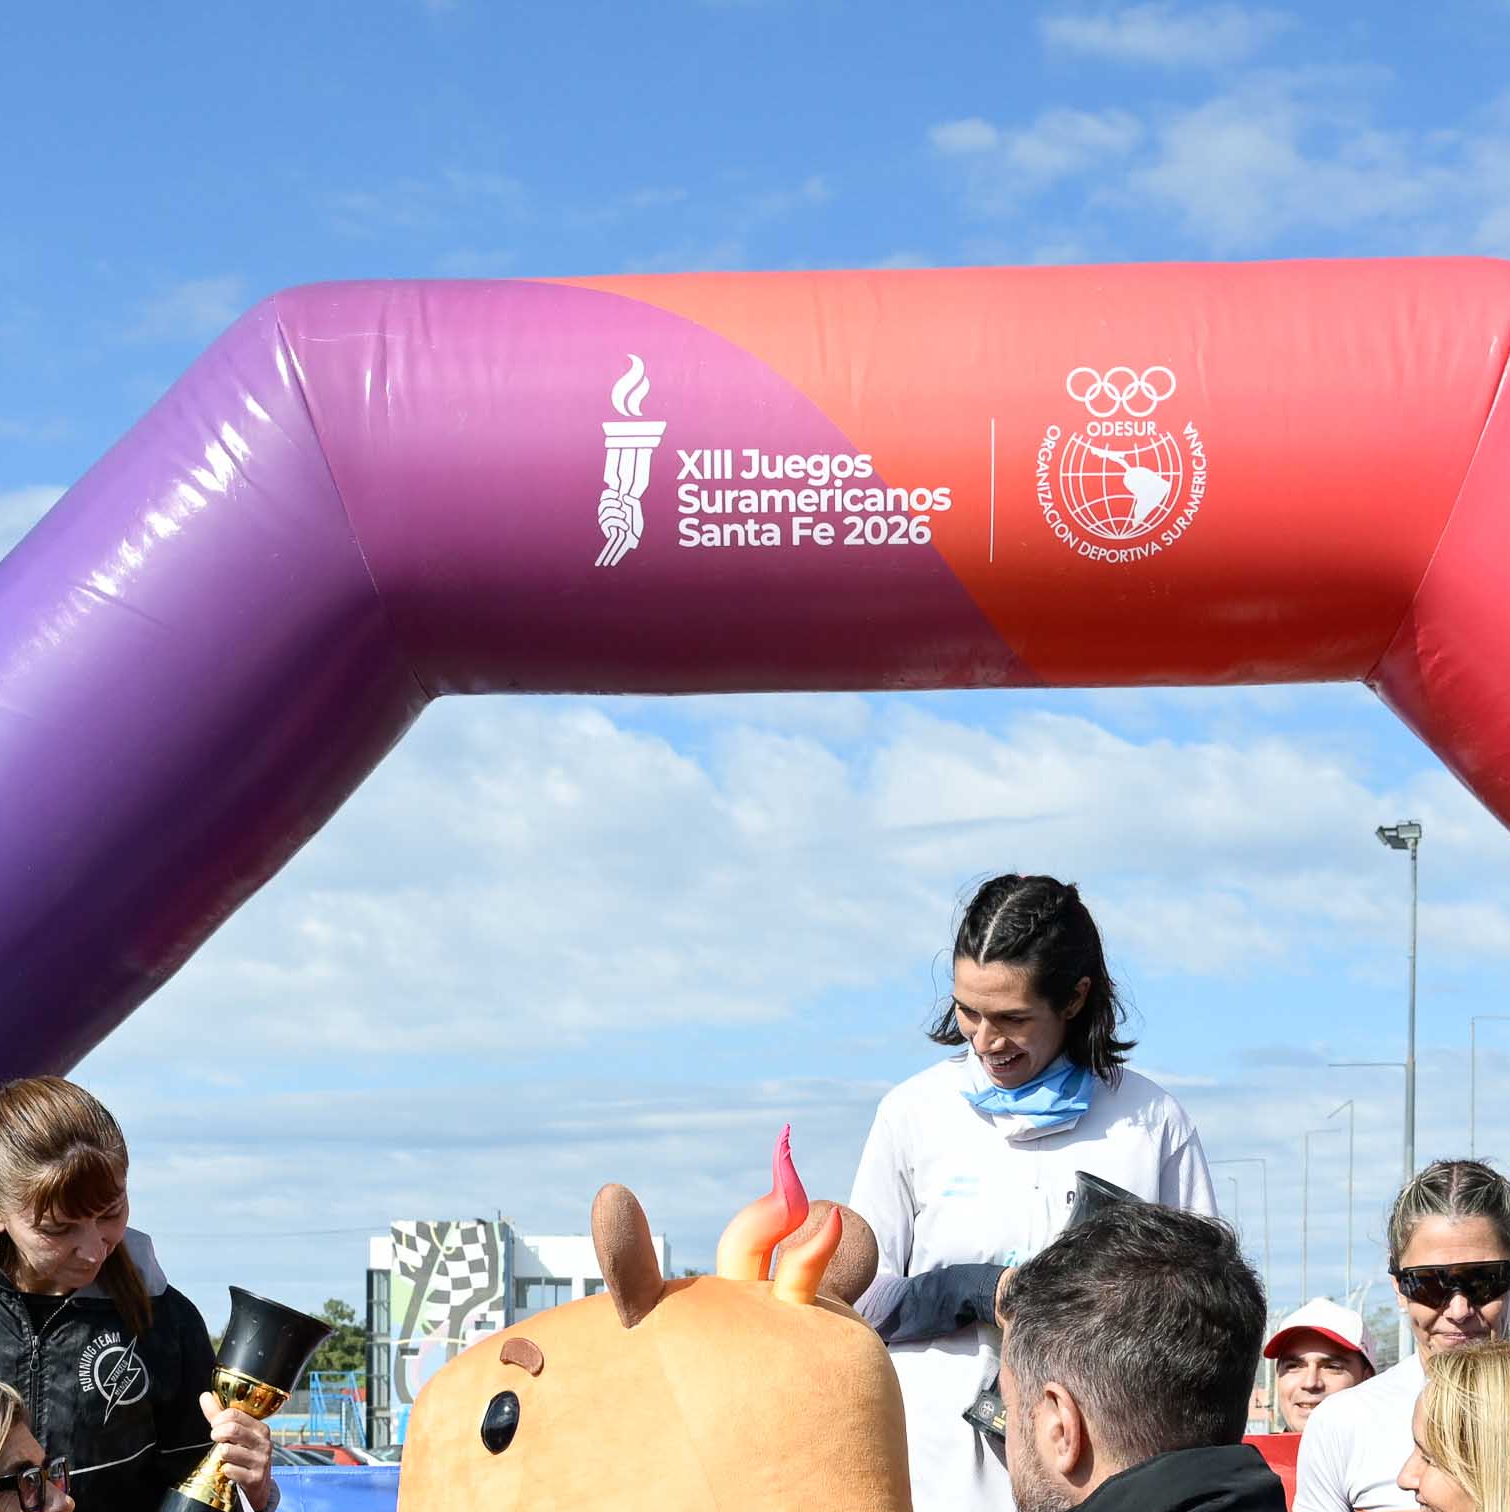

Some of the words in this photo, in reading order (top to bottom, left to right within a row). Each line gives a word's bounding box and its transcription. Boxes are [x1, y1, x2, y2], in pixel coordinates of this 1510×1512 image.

[1087, 421, 1157, 436] ODESUR
[676, 449, 732, 480] XIII
[740, 449, 873, 486] Juegos
[677, 479, 952, 514] Suramericanos
[1036, 425, 1079, 549] ORGANIZACION
[1078, 541, 1162, 564] DEPORTIVA
[1161, 420, 1207, 546] SURAMERICANA
[678, 517, 781, 548] Santa
[792, 516, 835, 546] Fe
[843, 515, 932, 545] 2026
[79, 1345, 97, 1392] RUNNING
[92, 1332, 121, 1349] TEAM
